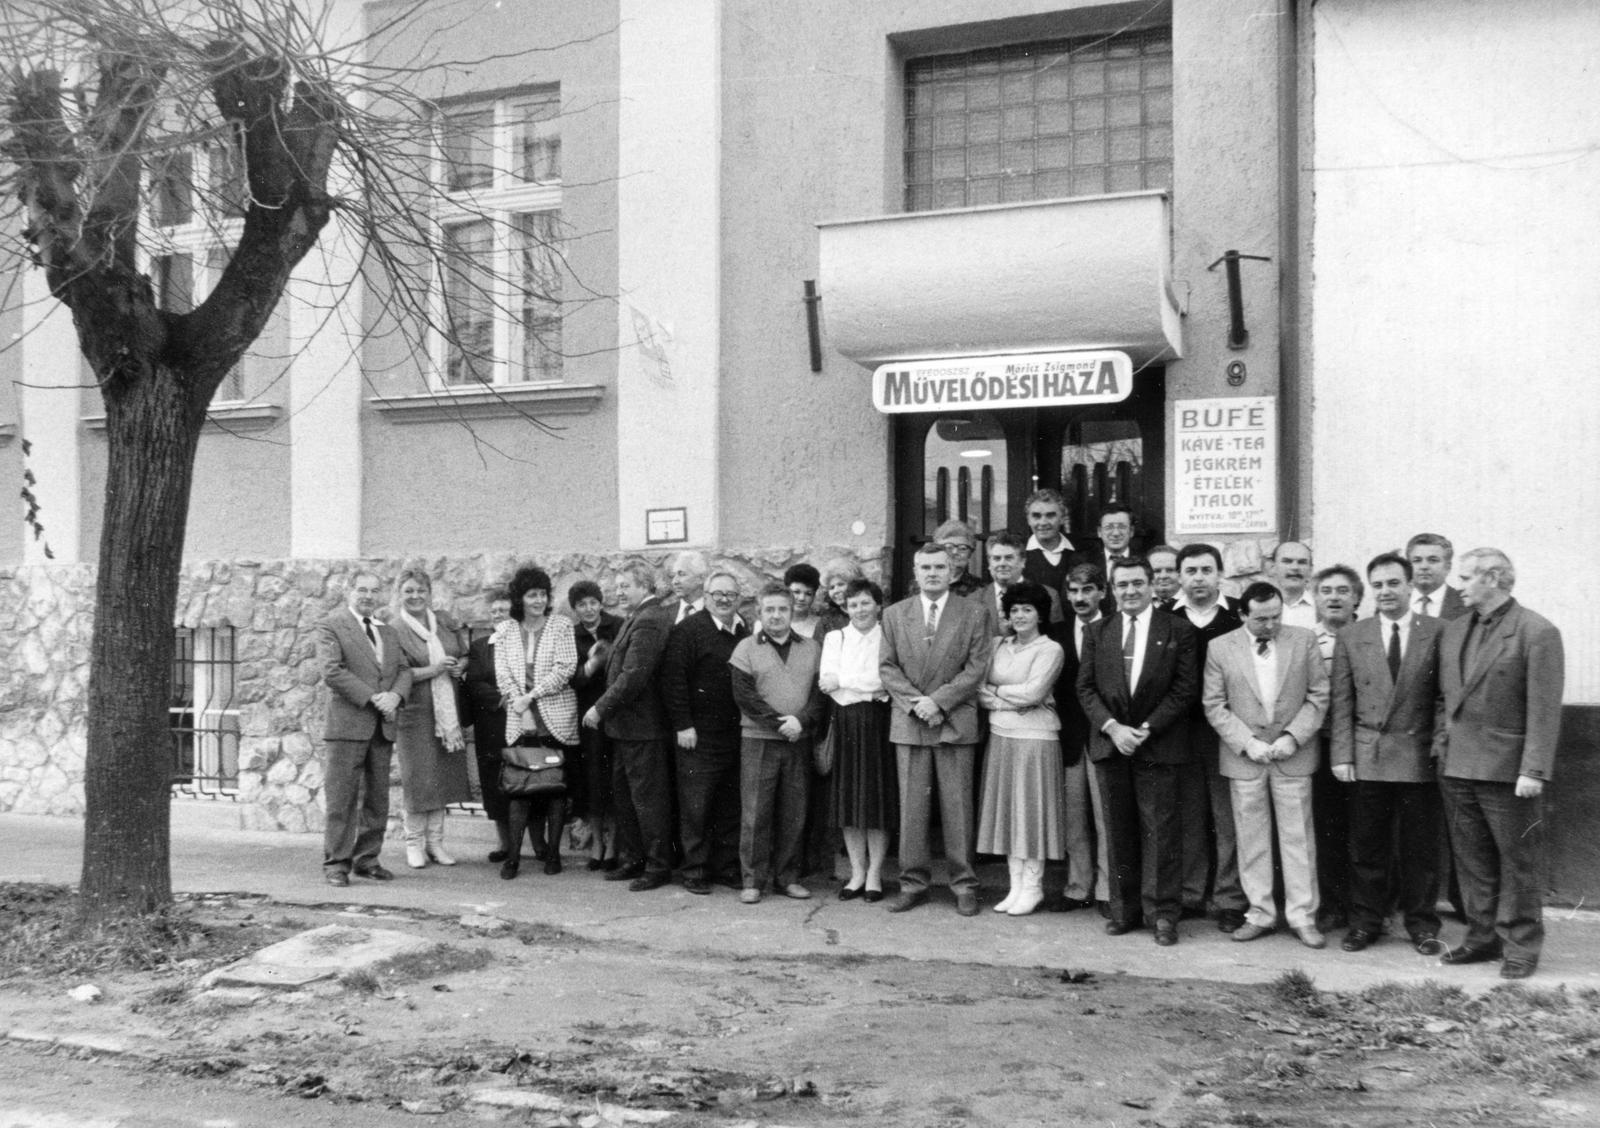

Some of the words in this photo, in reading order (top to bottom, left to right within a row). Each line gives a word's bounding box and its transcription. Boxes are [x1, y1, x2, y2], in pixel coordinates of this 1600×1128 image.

[1044, 360, 1096, 373] Zsigmond
[1226, 360, 1247, 387] 9
[884, 371, 1038, 405] MŰVELŐDÉSI
[1182, 402, 1265, 428] BUFÉ
[1185, 455, 1262, 474] JÉGKRÉM
[1193, 494, 1254, 507] ITALOK
